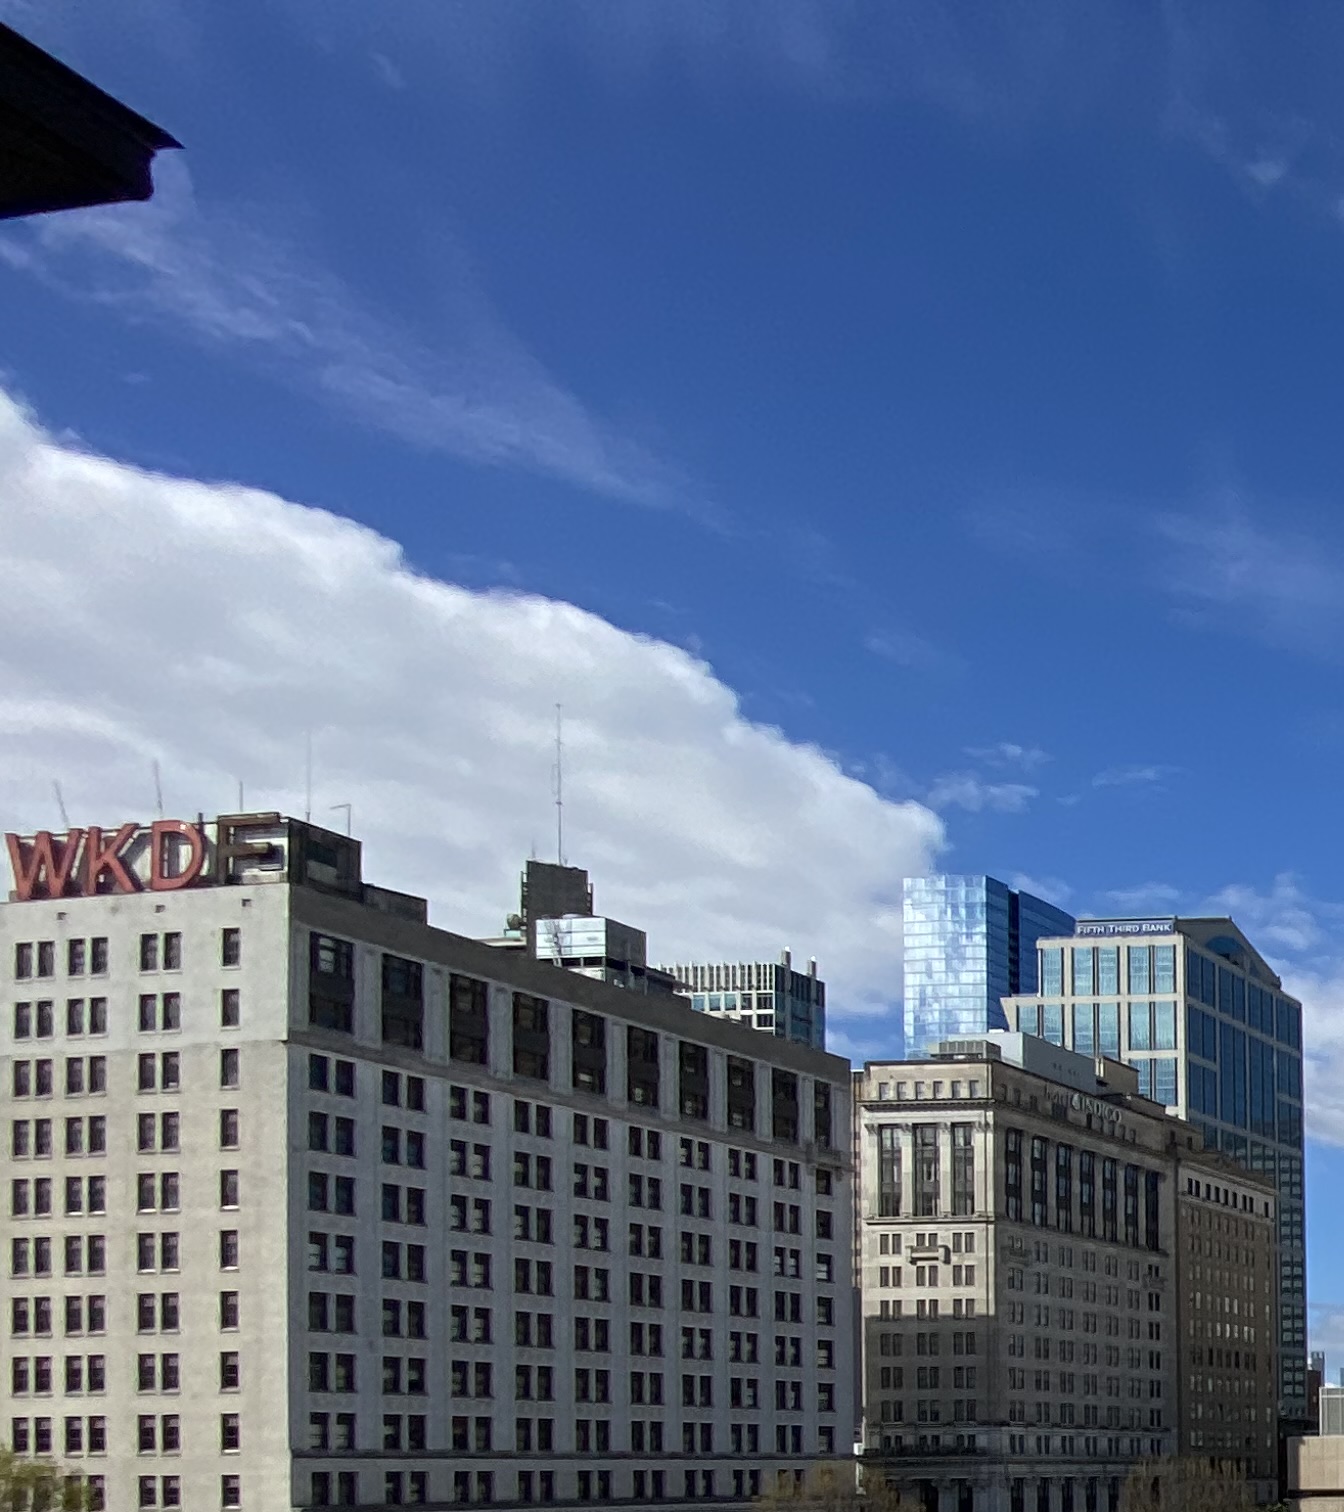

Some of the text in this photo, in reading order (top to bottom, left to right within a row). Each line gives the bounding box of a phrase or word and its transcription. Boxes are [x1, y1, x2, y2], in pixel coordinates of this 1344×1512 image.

[1077, 923, 1171, 934] FIFTH THIRD BANK
